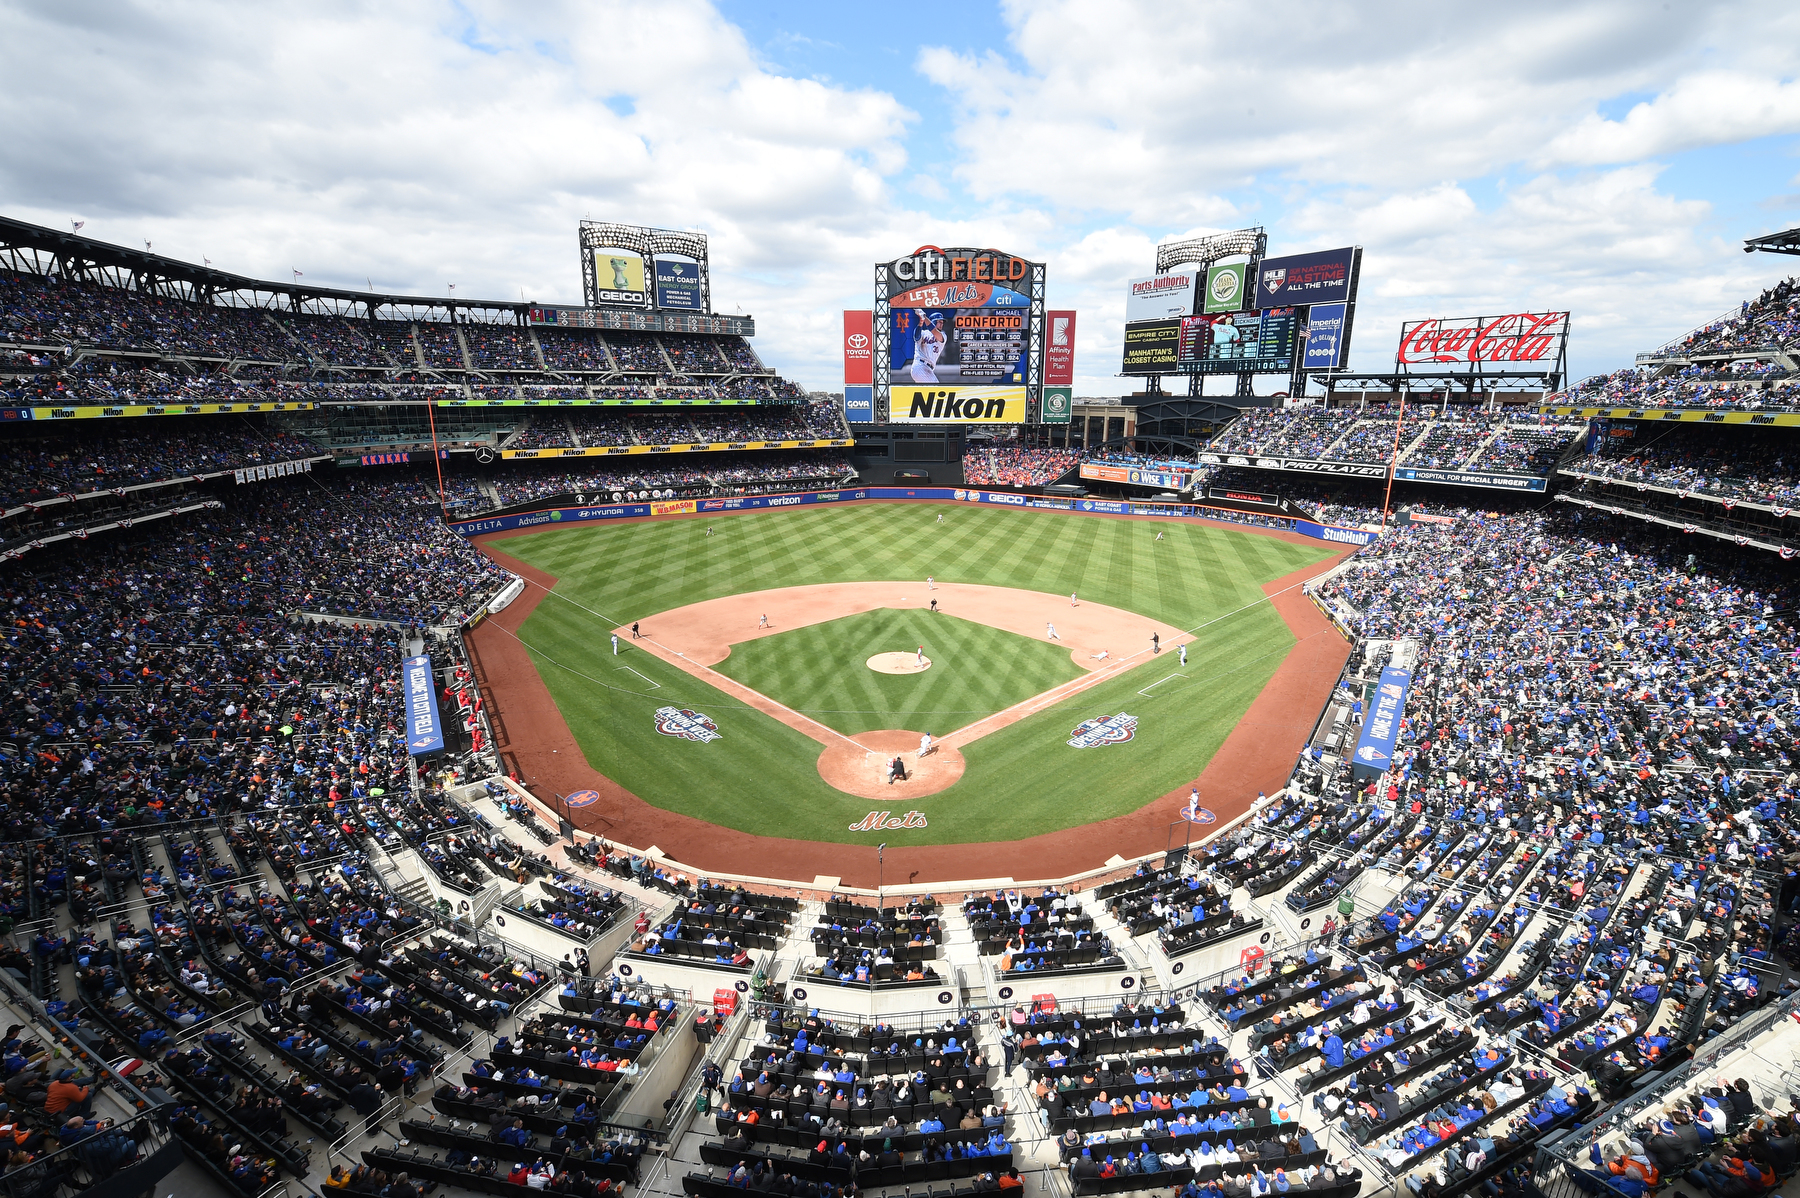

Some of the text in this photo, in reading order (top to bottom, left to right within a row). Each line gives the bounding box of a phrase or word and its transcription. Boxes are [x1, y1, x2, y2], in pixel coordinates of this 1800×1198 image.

[894, 251, 1026, 280] citi FIELD
[1302, 262, 1345, 273] NATIONAL
[677, 276, 698, 284] COAST
[1265, 270, 1284, 279] MLB
[1288, 270, 1344, 284] PASTIME
[1133, 275, 1190, 291] Parts Authority
[1323, 280, 1344, 288] TIME
[600, 291, 642, 302] GEICO
[909, 288, 938, 302] LET'S
[924, 284, 977, 307] GO Mets
[996, 296, 1012, 305] citi
[956, 317, 1020, 327] CONFORTO
[1311, 318, 1341, 326] Imperial
[1398, 311, 1570, 363] Coca-Cola
[1129, 348, 1172, 356] MANHATTAN'S
[1152, 355, 1177, 363] CASINO
[909, 391, 1006, 418] Nikon
[21, 410, 28, 418] 0
[52, 409, 75, 418] Nikon
[103, 408, 123, 416] Nikon
[1704, 413, 1724, 422] Nikon
[1750, 414, 1775, 424] Nikon
[1285, 461, 1318, 470] PRO
[1318, 464, 1384, 475] PLAYER
[1416, 472, 1445, 480] HOSPITAL
[1461, 476, 1491, 484] SPECIAL
[1493, 478, 1529, 487] SURGERY
[768, 496, 800, 506] verizon
[989, 494, 1023, 504] GEICO
[1226, 492, 1262, 501] HONDA
[468, 520, 502, 532] DELTA
[519, 515, 550, 526] Advisors
[1323, 528, 1369, 545] StubHub!
[410, 666, 428, 694] WELCOME
[412, 692, 429, 702] TO
[1370, 696, 1398, 740] HOME OF THE
[414, 714, 433, 735] FIELD
[656, 706, 723, 744] OPENING WEEK
[1066, 711, 1139, 748] OPENING WEEK
[848, 810, 928, 831] Mets
